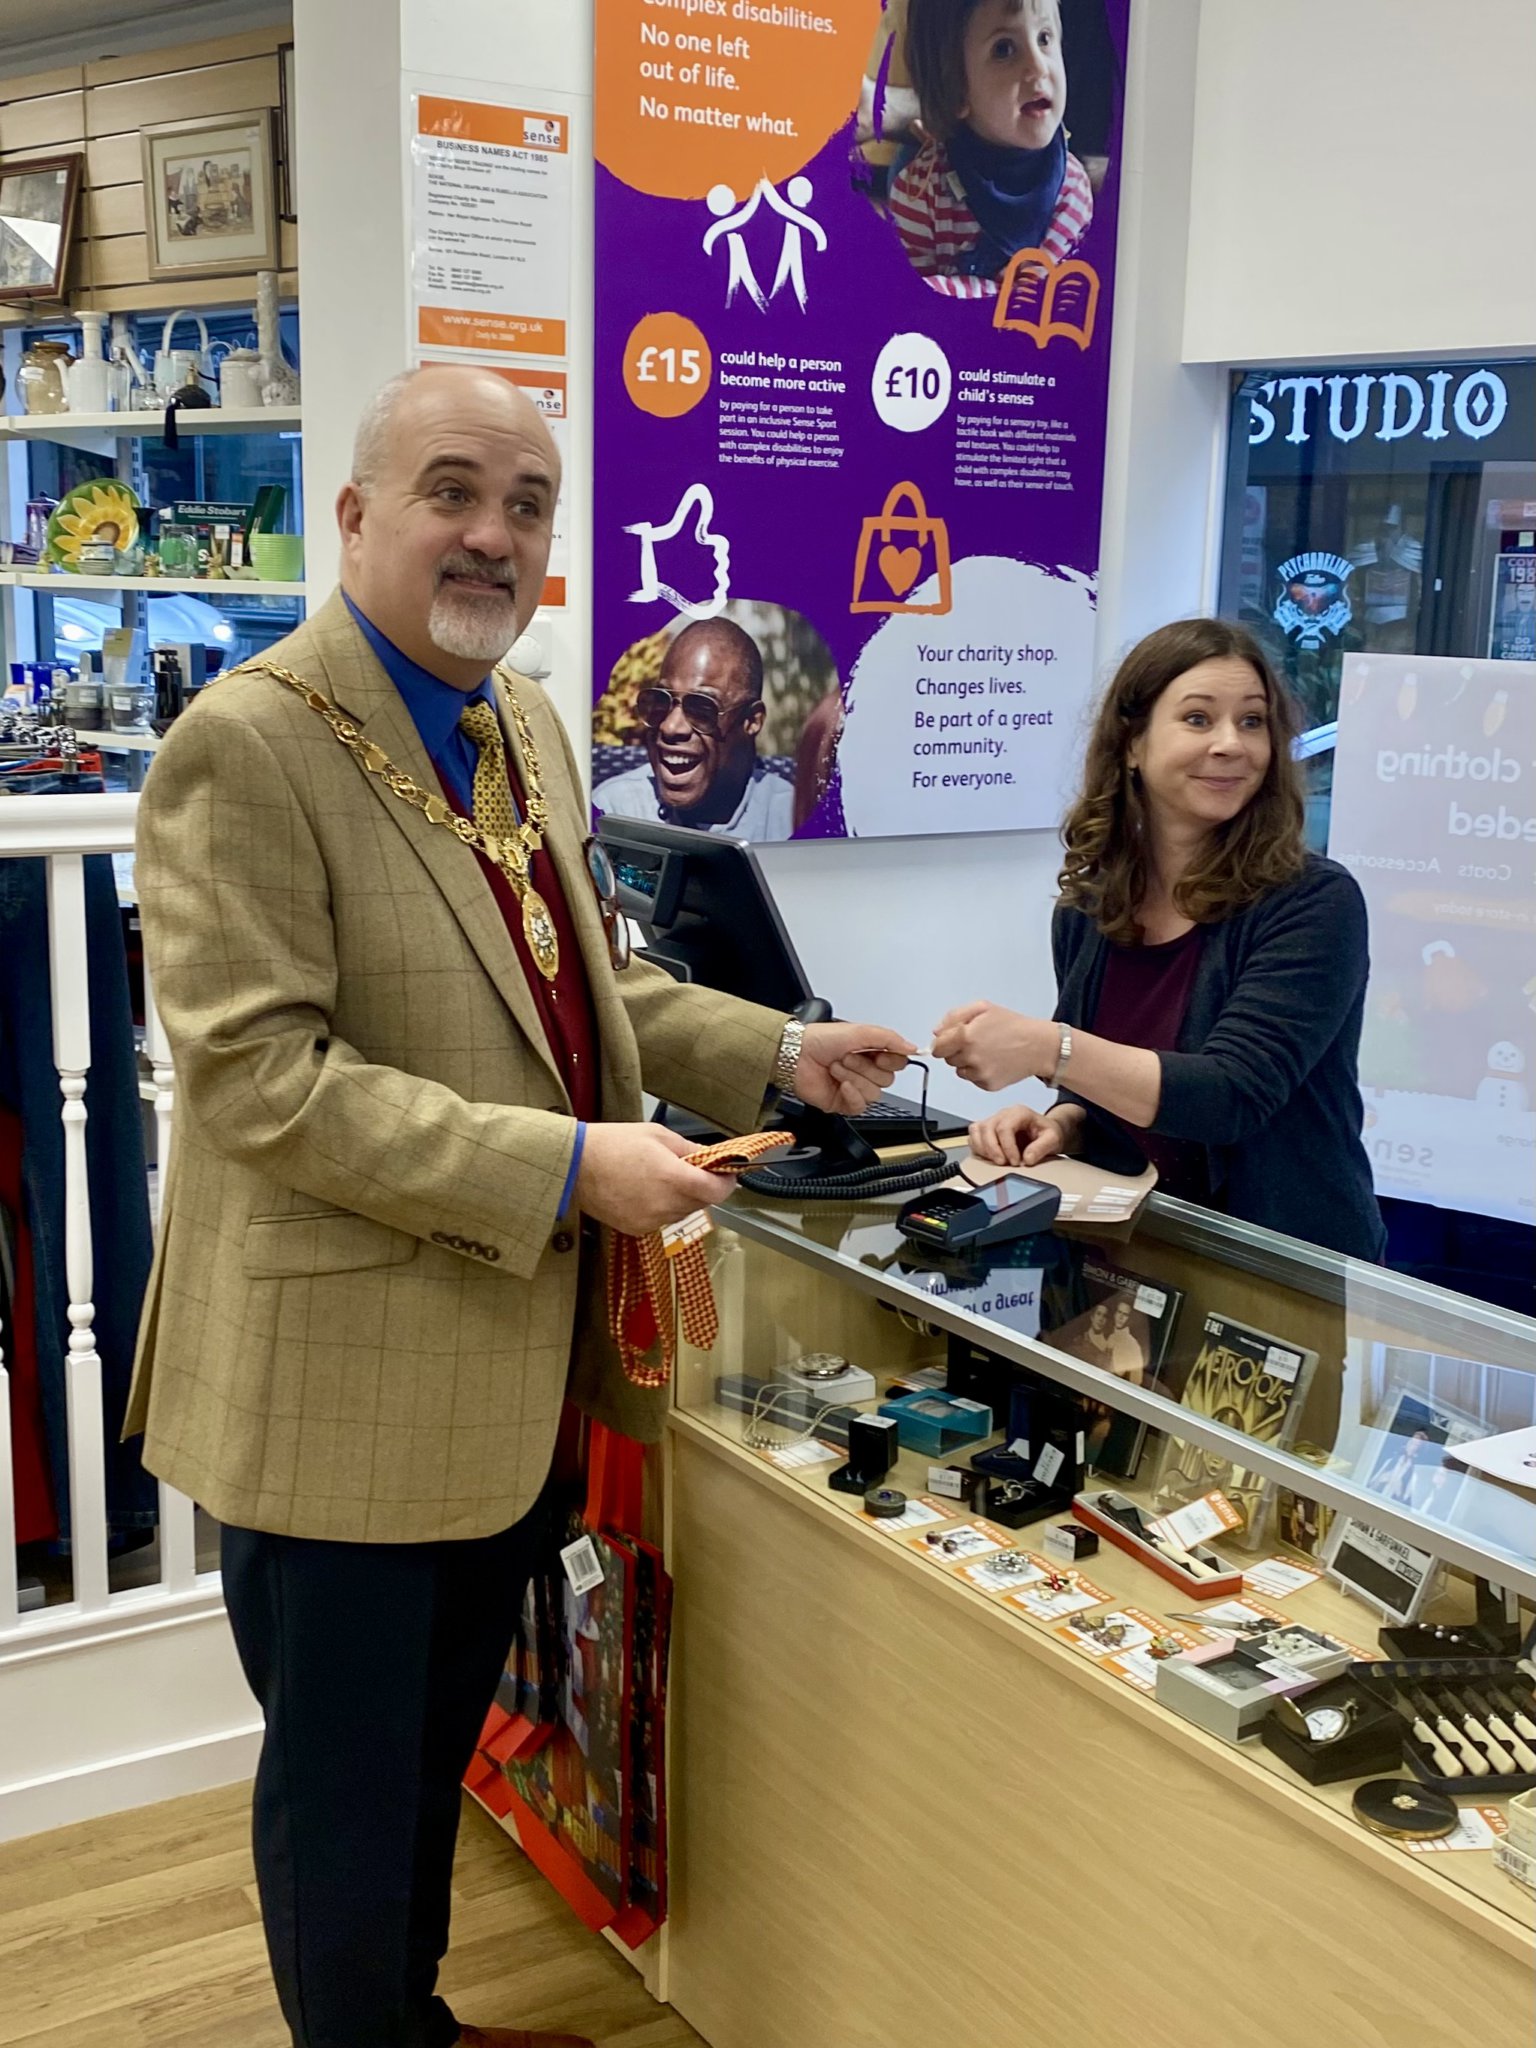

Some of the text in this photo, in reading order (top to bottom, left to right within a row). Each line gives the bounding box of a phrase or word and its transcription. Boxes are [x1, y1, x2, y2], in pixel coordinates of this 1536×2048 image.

[643, 0, 837, 34] mplex disabilities.
[640, 22, 750, 59] No one left
[640, 61, 740, 90] out of life.
[640, 95, 798, 137] No matter what.
[523, 131, 560, 145] sense
[437, 140, 479, 154] BUSINESS
[482, 144, 510, 158] NAMES
[512, 152, 528, 160] ACT
[442, 314, 543, 333] www.sense.org.uk
[636, 346, 701, 384] £15
[720, 351, 842, 373] could help a person
[720, 371, 846, 393] become more active
[885, 366, 940, 399] £10
[959, 369, 1056, 387] could stimulate a
[719, 399, 729, 411] by
[731, 401, 758, 413] paying
[759, 401, 770, 411] for
[779, 404, 805, 415] person
[806, 405, 815, 414] to
[816, 405, 833, 415] take
[958, 388, 1035, 406] child's senses
[1249, 368, 1508, 445] STUDIO
[719, 414, 736, 425] part
[738, 415, 746, 424] in
[759, 416, 791, 427] inclusive
[792, 418, 815, 428] Sense
[816, 418, 837, 429] Sport
[719, 427, 749, 437] session.
[751, 428, 764, 438] You
[767, 429, 788, 439] could
[789, 430, 805, 441] help
[814, 434, 839, 443] person
[719, 441, 844, 457] with complex disabilities to enjoy
[719, 454, 839, 468] the benefits of physical exercise.
[178, 504, 247, 516] Eddie Stobart
[917, 644, 1058, 666] Your charity shop.
[916, 677, 1026, 699] Changes lives.
[914, 709, 1053, 732] Be part of a great
[913, 738, 1007, 758] community.
[912, 771, 1016, 790] For everyone.
